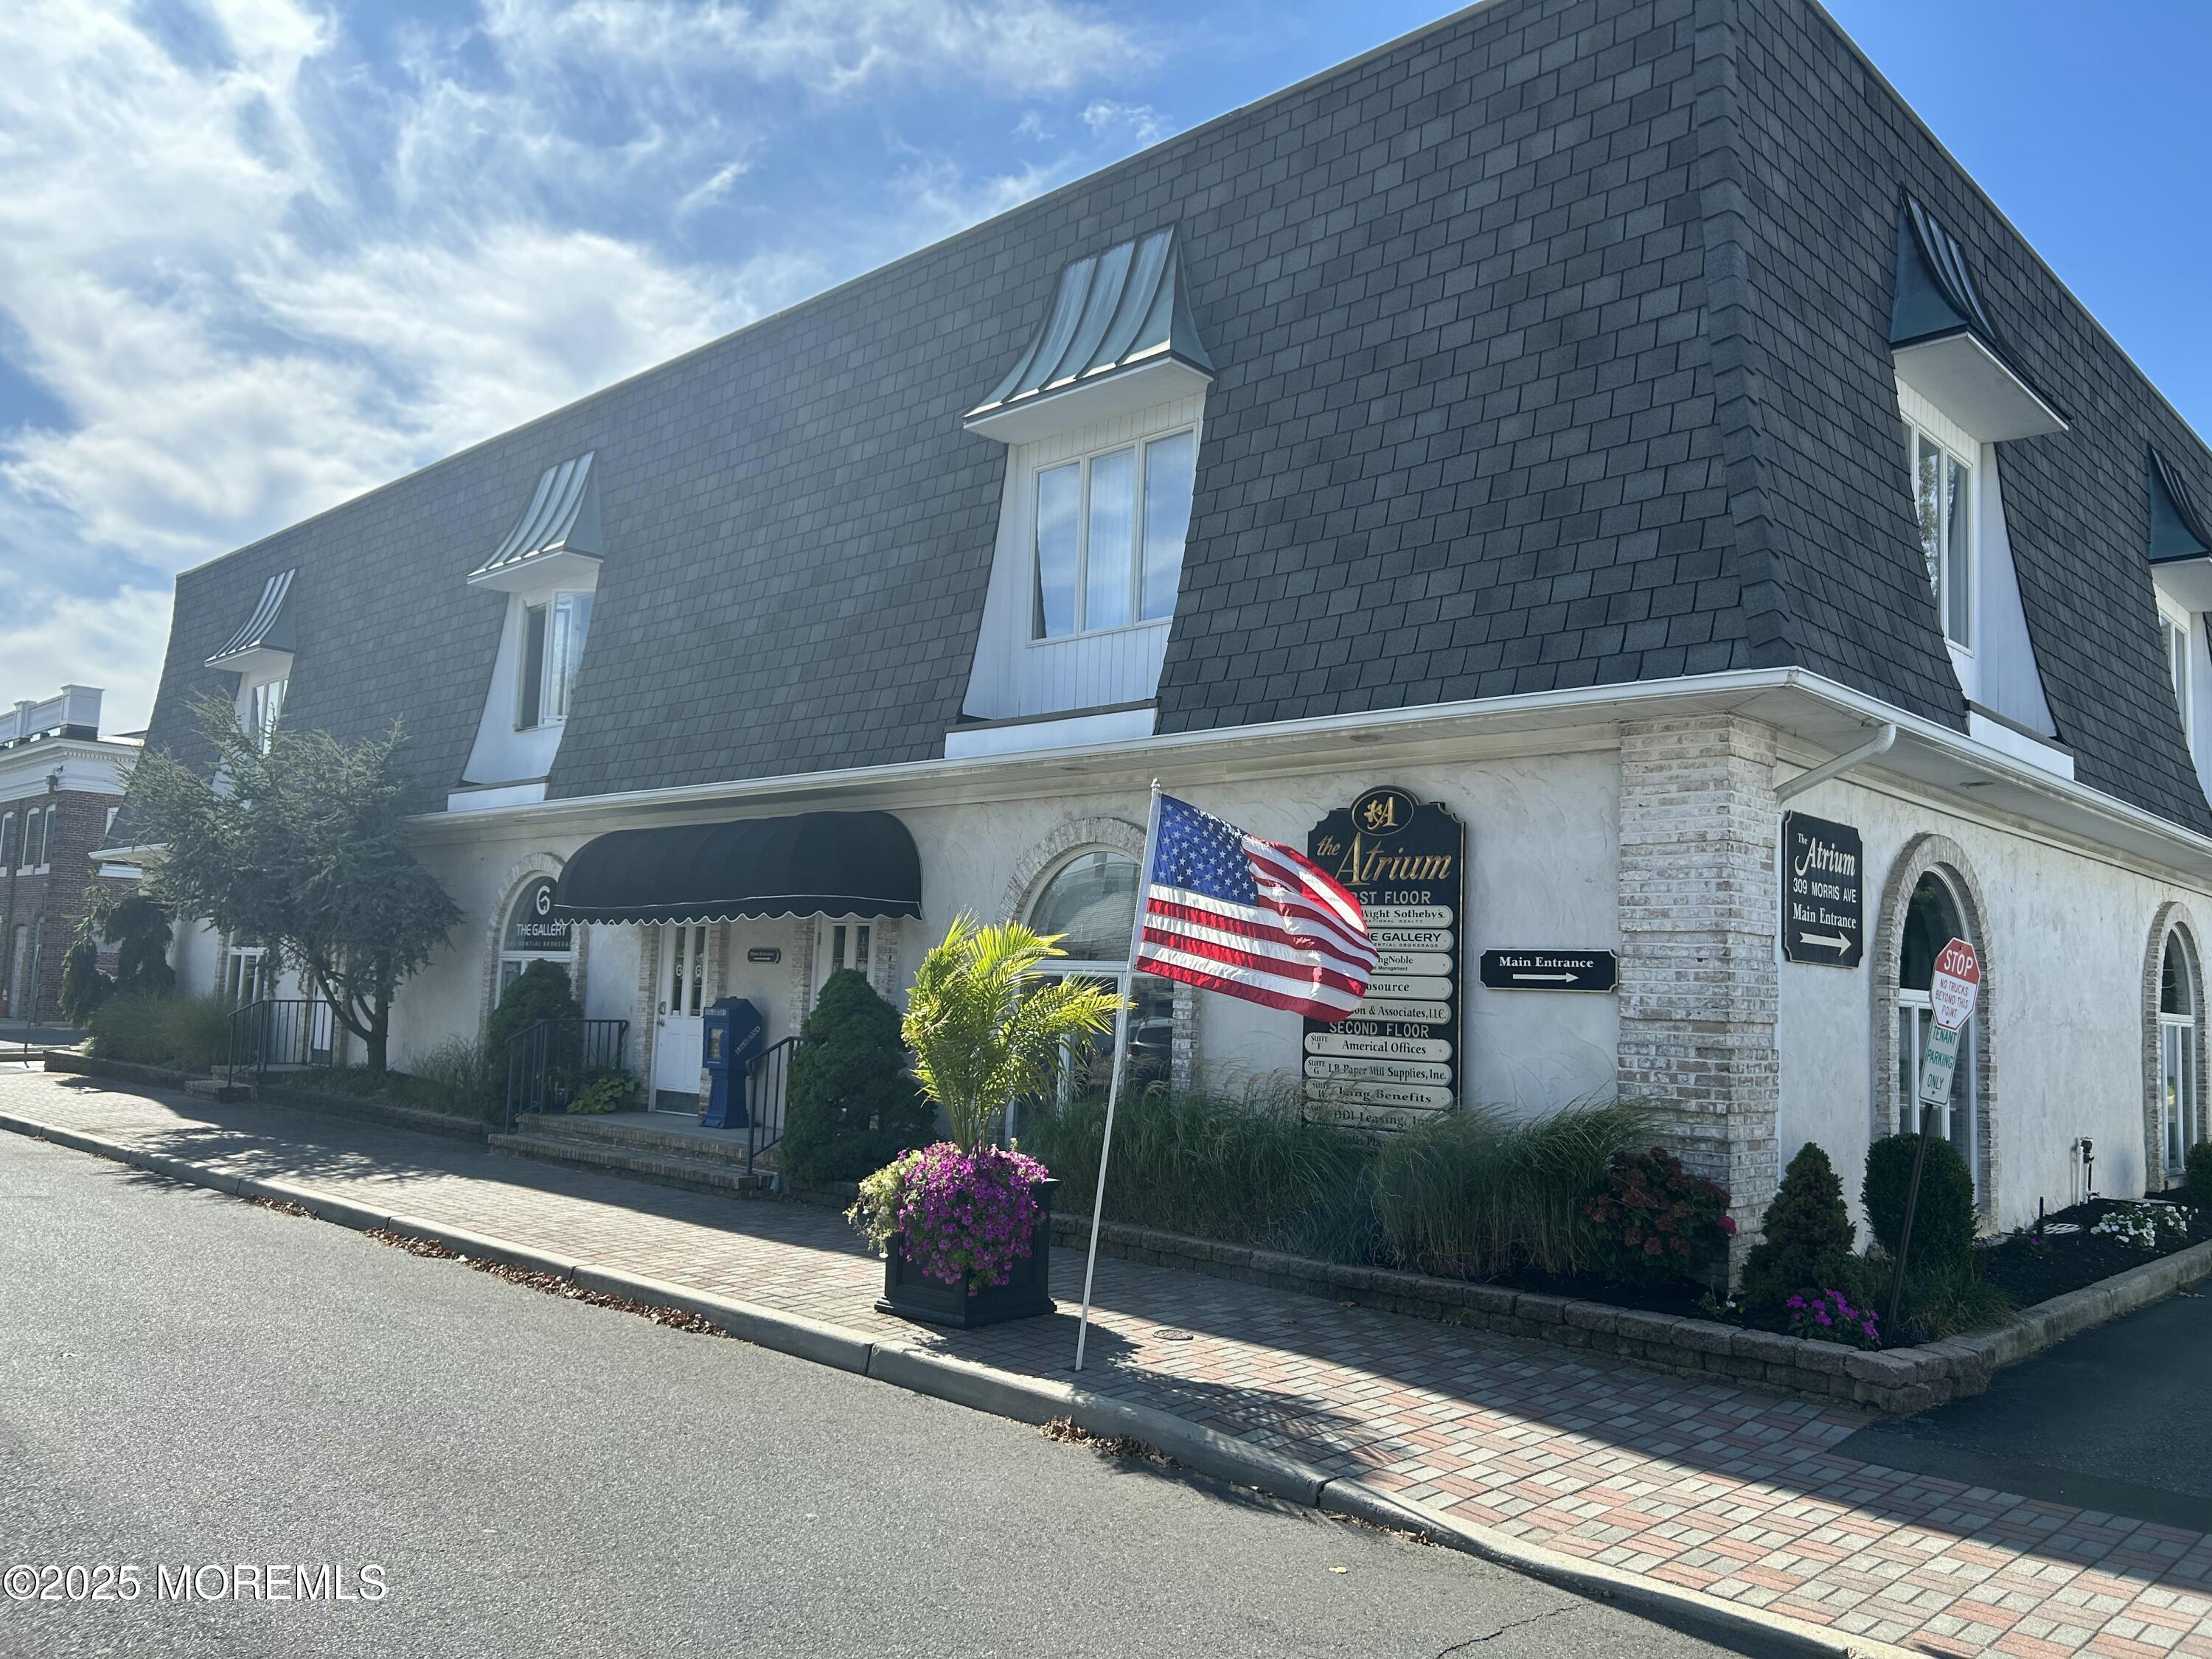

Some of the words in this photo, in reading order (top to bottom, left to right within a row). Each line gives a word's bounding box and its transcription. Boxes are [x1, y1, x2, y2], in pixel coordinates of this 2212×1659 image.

[1798, 832, 1808, 845] The
[1317, 835, 1340, 855] the
[1335, 832, 1452, 886] Atrium
[1795, 838, 1855, 877] Atrium
[1793, 877, 1807, 894] 309
[1812, 881, 1840, 900] MORRIS
[1843, 888, 1857, 903] AVE
[1385, 891, 1430, 905] FLOOR
[1394, 909, 1443, 919] Sotheby's
[1793, 902, 1815, 922] Main
[1819, 907, 1857, 929] Entrance
[516, 924, 532, 936] THE
[532, 924, 566, 936] GALLERY
[1382, 933, 1441, 942] GALLERY
[1499, 956, 1531, 967] Main
[1535, 956, 1593, 967] Entrance
[1944, 949, 1973, 977] STOP
[1940, 978, 1947, 989] NO
[1949, 981, 1968, 995] TRUCKS
[1935, 990, 1955, 1006] BEYOND
[1958, 993, 1969, 1009] THIS
[1368, 1005, 1376, 1015] &
[1941, 1005, 1958, 1018] POINT
[1329, 1021, 1377, 1035] SECOND
[1386, 1023, 1429, 1038] FLOOR
[1933, 1026, 1957, 1046] TENANT
[1342, 1040, 1388, 1051] Americal
[1391, 1042, 1426, 1054] Offices
[1927, 1049, 1953, 1069] PARKING
[1388, 1067, 1427, 1081] Supplies,
[1430, 1069, 1447, 1080] Inc.
[1927, 1074, 1944, 1090] ONLY
[1376, 1089, 1431, 1102] Benefits
